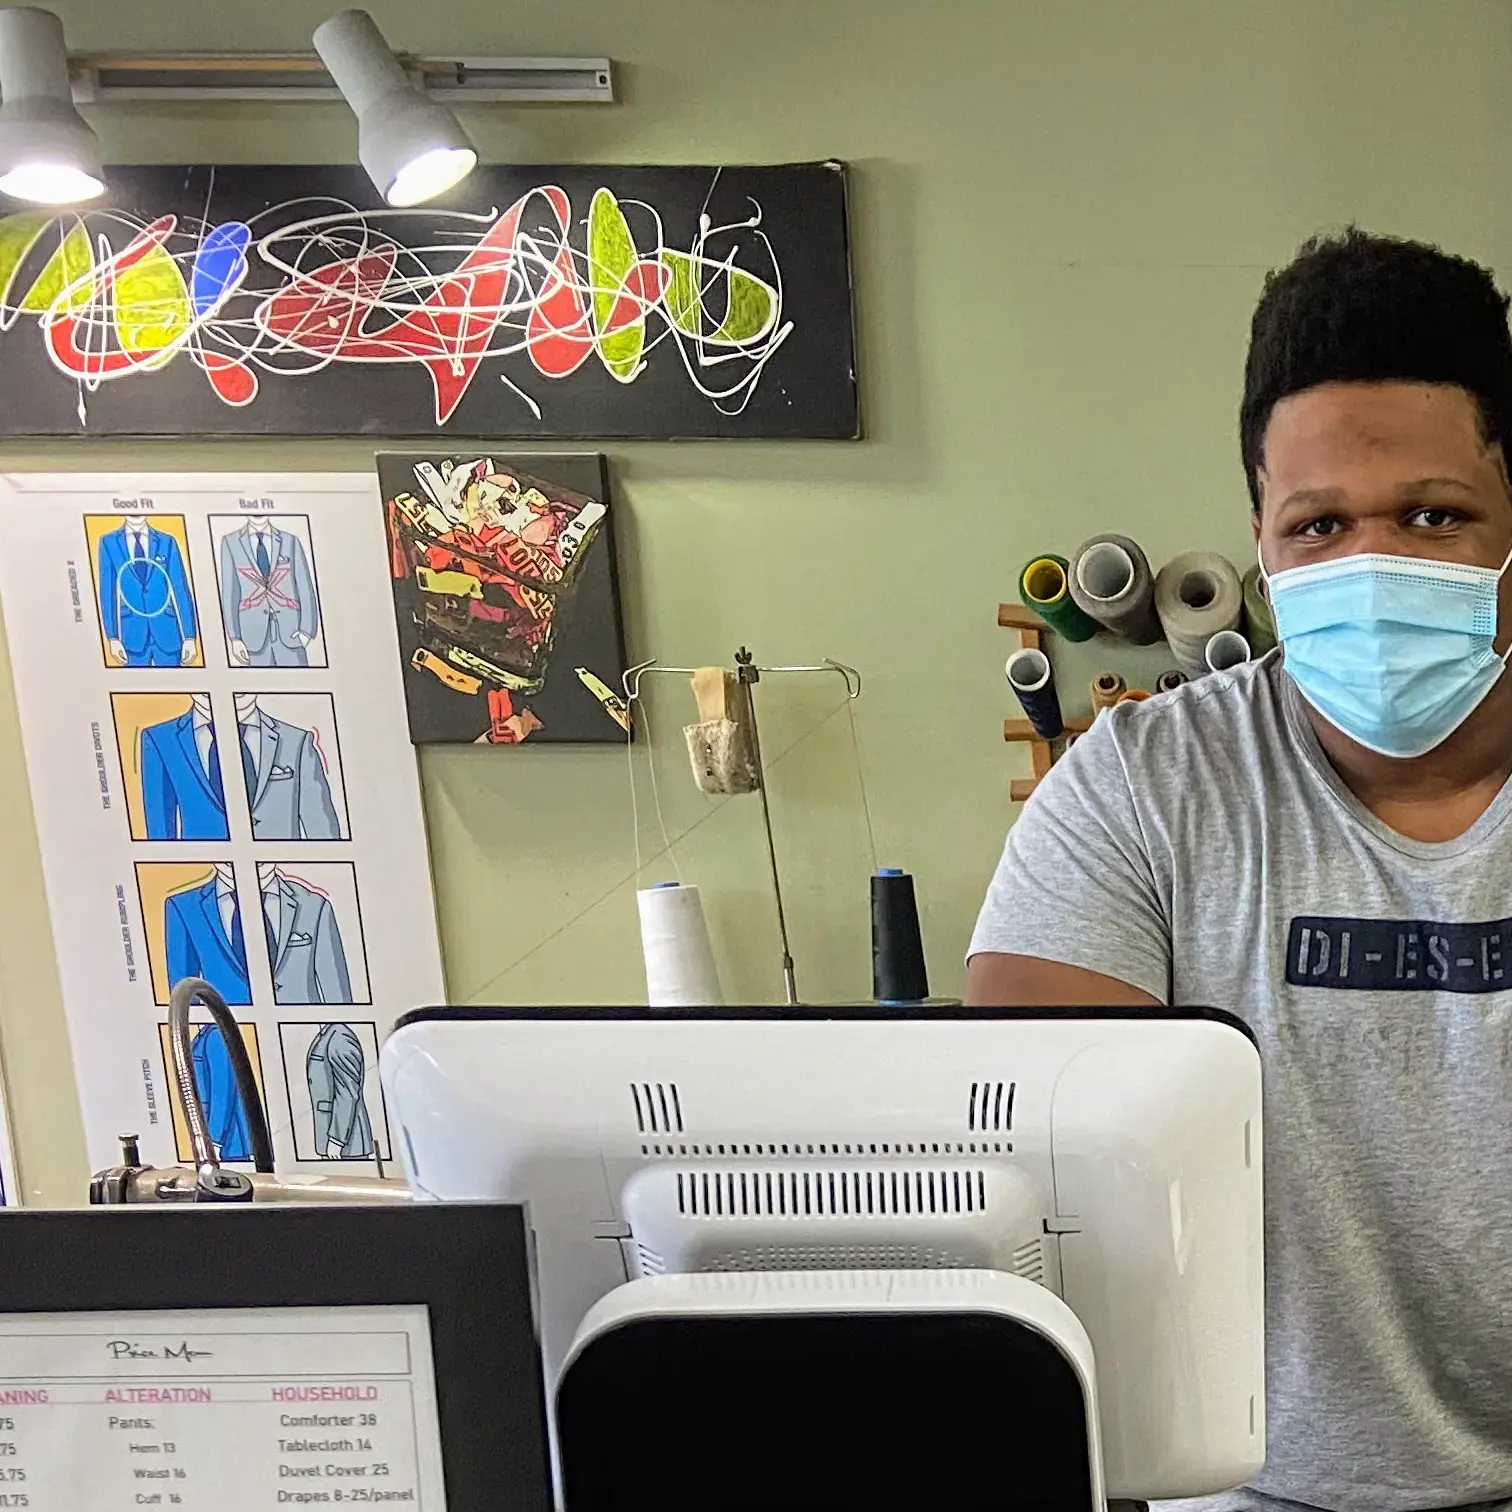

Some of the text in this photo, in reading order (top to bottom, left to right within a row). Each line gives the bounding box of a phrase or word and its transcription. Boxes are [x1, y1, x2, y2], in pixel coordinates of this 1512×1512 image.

[112, 498, 154, 509] Good Fit
[239, 498, 274, 509] Bad Fit
[105, 1388, 213, 1403] ALTERATION
[271, 1386, 379, 1401] HOUSEHOLD
[280, 1414, 355, 1426] Comforter
[129, 1443, 176, 1453] Hem 13
[277, 1439, 372, 1451] Tablecloth 14
[133, 1469, 170, 1478] Waist
[279, 1463, 390, 1477] Duvet Cover 25
[277, 1488, 414, 1503] Drapes 8-25/panel
